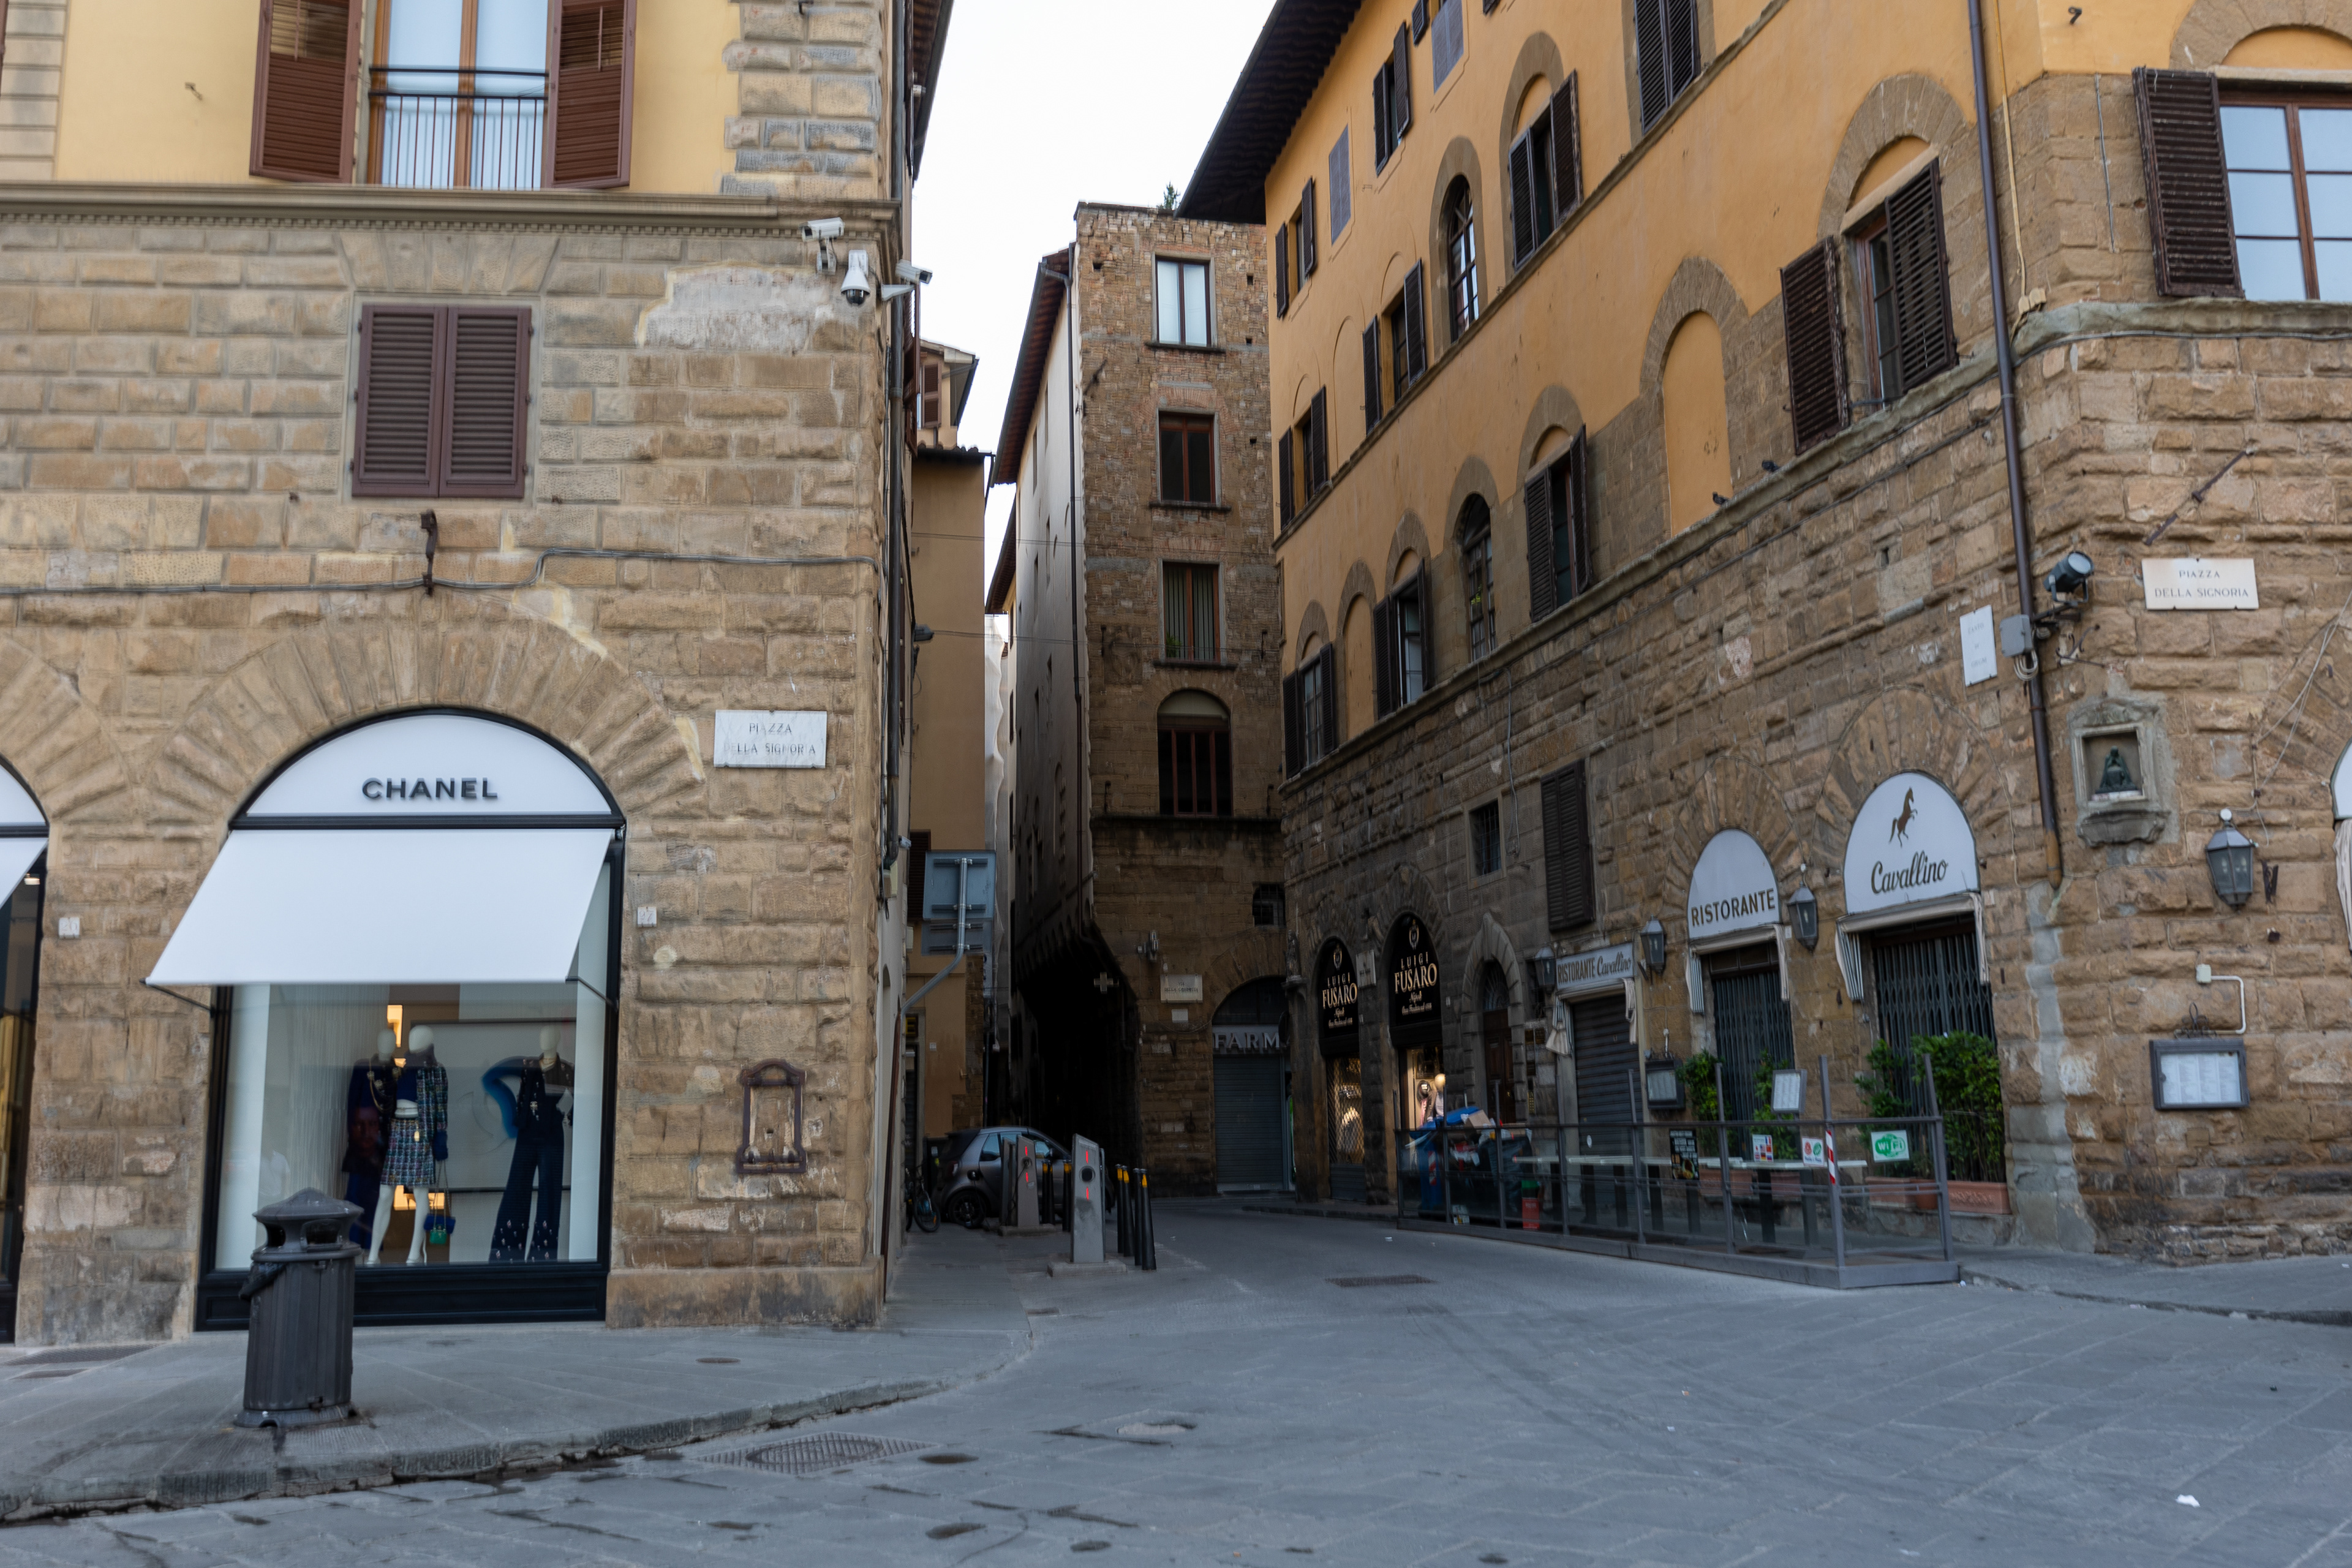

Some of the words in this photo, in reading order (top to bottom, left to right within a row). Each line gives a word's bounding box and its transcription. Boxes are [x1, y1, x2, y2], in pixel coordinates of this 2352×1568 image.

[2154, 588, 2192, 598] DELLA
[2196, 588, 2248, 598] SIGNORIA
[749, 723, 791, 733] PIAZZA
[724, 742, 758, 753] DELLA
[362, 777, 497, 799] CHANEL
[1871, 850, 1948, 894] Cavallino
[1691, 888, 1775, 926] RISTORANTE
[1401, 952, 1428, 970] LUIGI
[1558, 957, 1596, 984] RISTORANTE
[1597, 951, 1631, 976] Cavallino
[1327, 972, 1351, 988] LUIGI
[1394, 963, 1438, 993] FUSARO
[1322, 982, 1357, 1009] FUSARO
